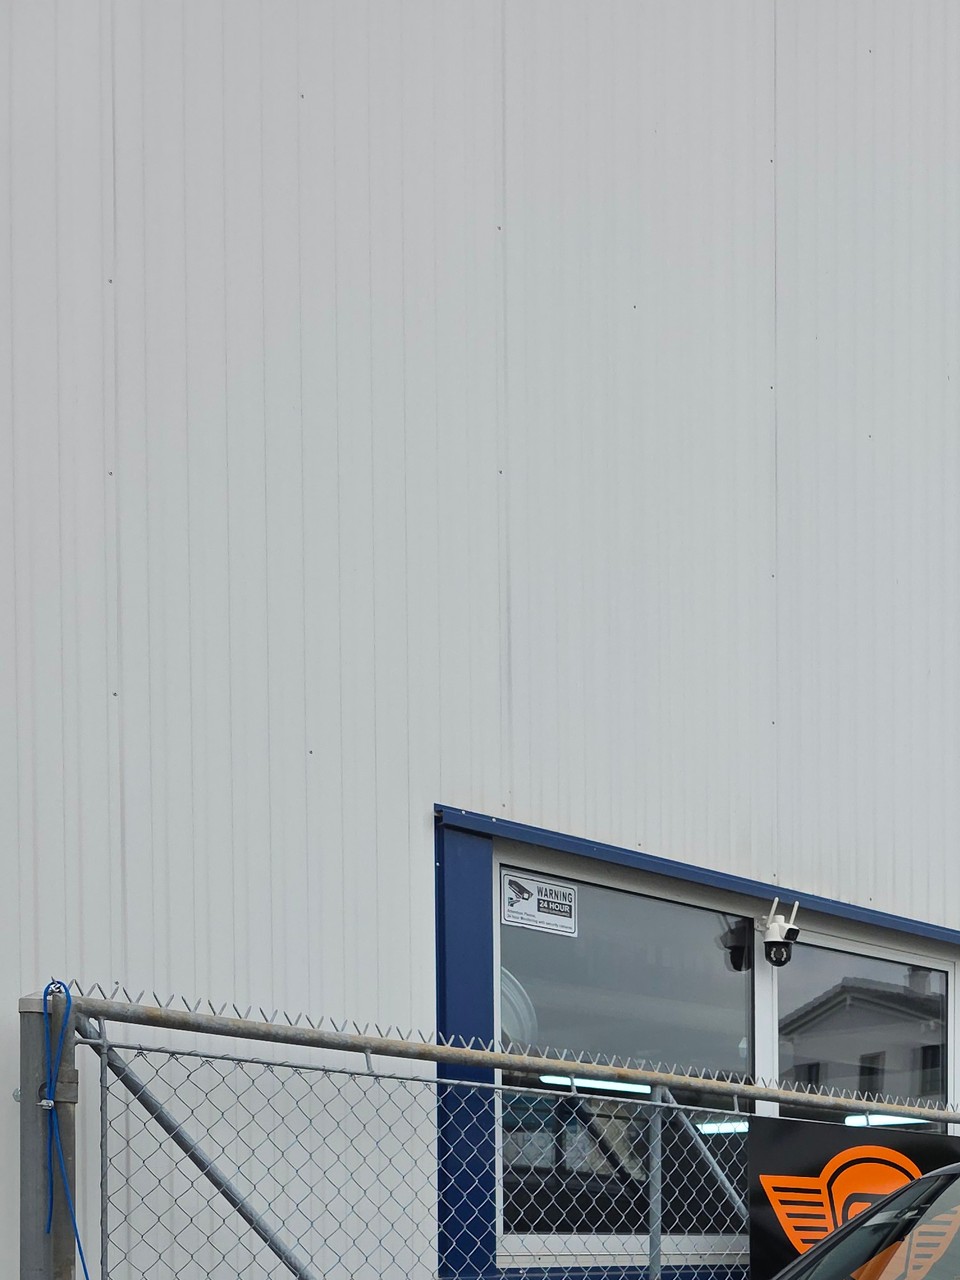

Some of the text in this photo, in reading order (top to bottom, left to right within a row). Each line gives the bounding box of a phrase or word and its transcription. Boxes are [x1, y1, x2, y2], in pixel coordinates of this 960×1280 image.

[537, 886, 573, 903] WARNING
[539, 900, 548, 908] 24
[549, 902, 570, 913] HOUR
